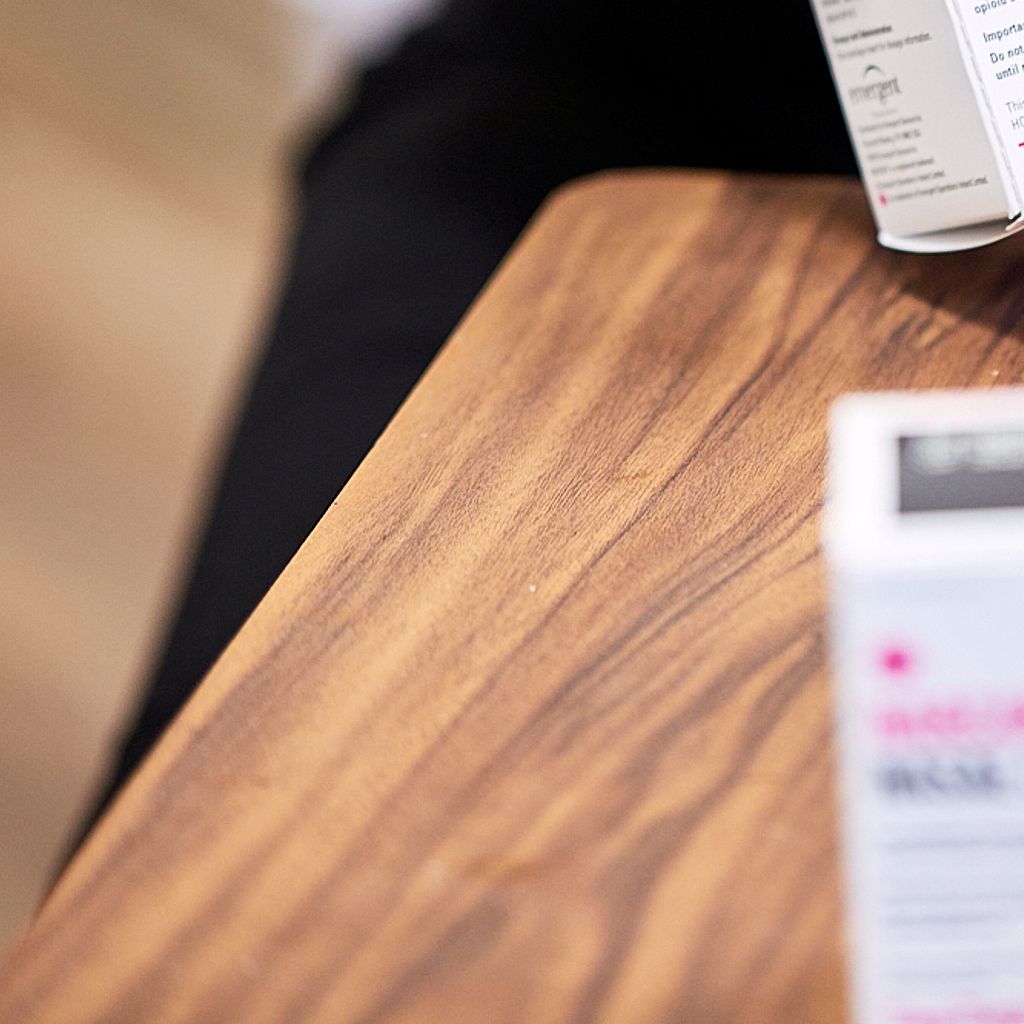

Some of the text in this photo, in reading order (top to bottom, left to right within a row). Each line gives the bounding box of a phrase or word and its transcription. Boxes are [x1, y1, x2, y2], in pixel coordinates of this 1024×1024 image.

[989, 51, 1005, 65] Do
[1007, 44, 1024, 59] not
[995, 63, 1020, 81] until
